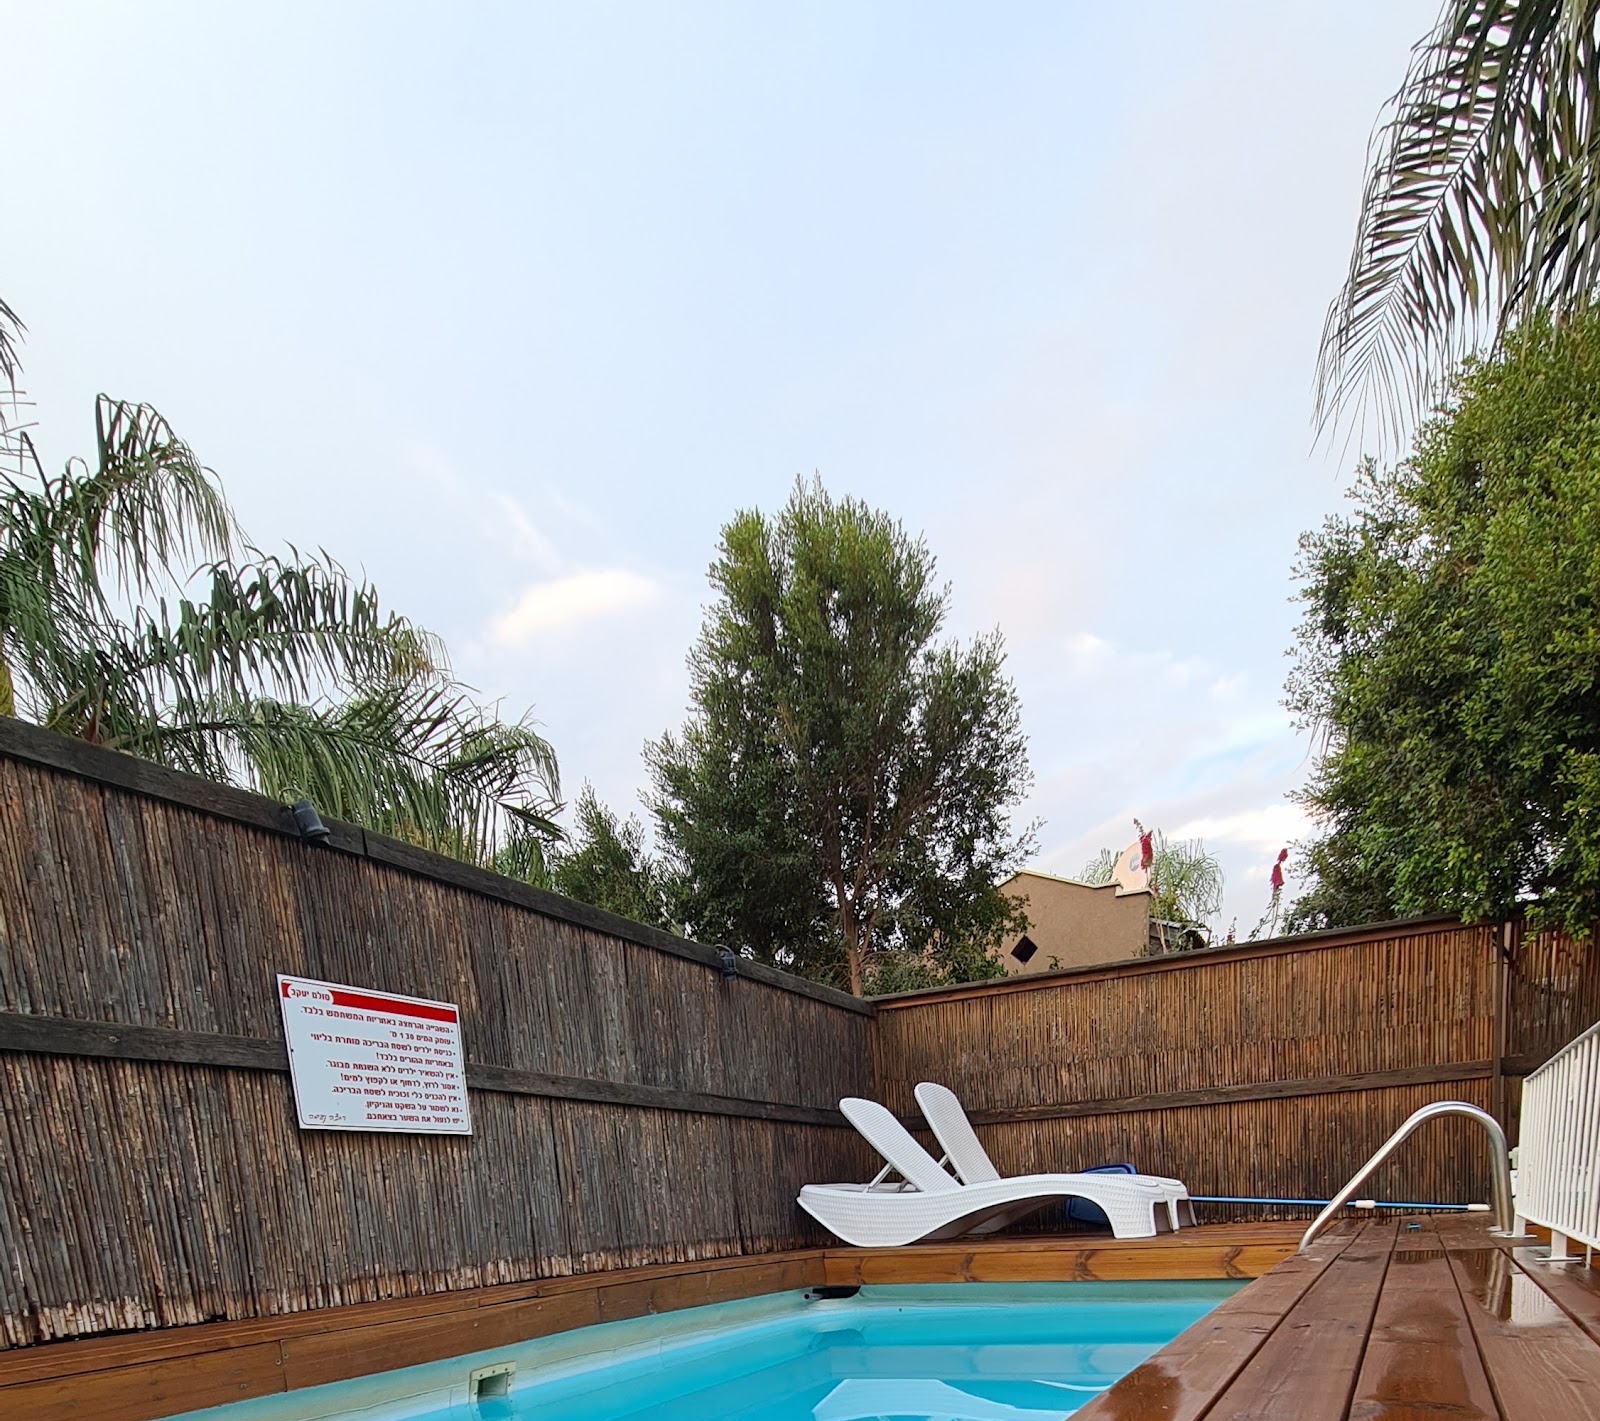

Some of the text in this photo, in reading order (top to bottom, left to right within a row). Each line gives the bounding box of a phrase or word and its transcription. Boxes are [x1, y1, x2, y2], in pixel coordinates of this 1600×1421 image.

[291, 988, 330, 1000] סולם יעקב
[301, 1006, 450, 1033] השהייה והרחצה באחריות המשתמש בלבד.
[311, 1033, 332, 1042] בליווי
[335, 1036, 360, 1045] מותרת
[435, 1037, 450, 1045] עומק
[363, 1040, 389, 1048] הבריכה
[391, 1043, 412, 1051] לשטח
[414, 1045, 431, 1053] ילדים
[376, 1052, 397, 1061] בלבד!
[400, 1056, 423, 1064] ההורים
[398, 1067, 416, 1075] ילדים
[418, 1070, 444, 1078] להשאיר
[341, 1073, 362, 1082] למים!
[365, 1076, 388, 1085] לקפוץ
[400, 1079, 420, 1088] לדחוף
[364, 1088, 385, 1096] לשטח
[388, 1090, 409, 1098] זכוכית
[395, 1102, 416, 1110] השקט
[432, 1115, 450, 1123] לנעול
